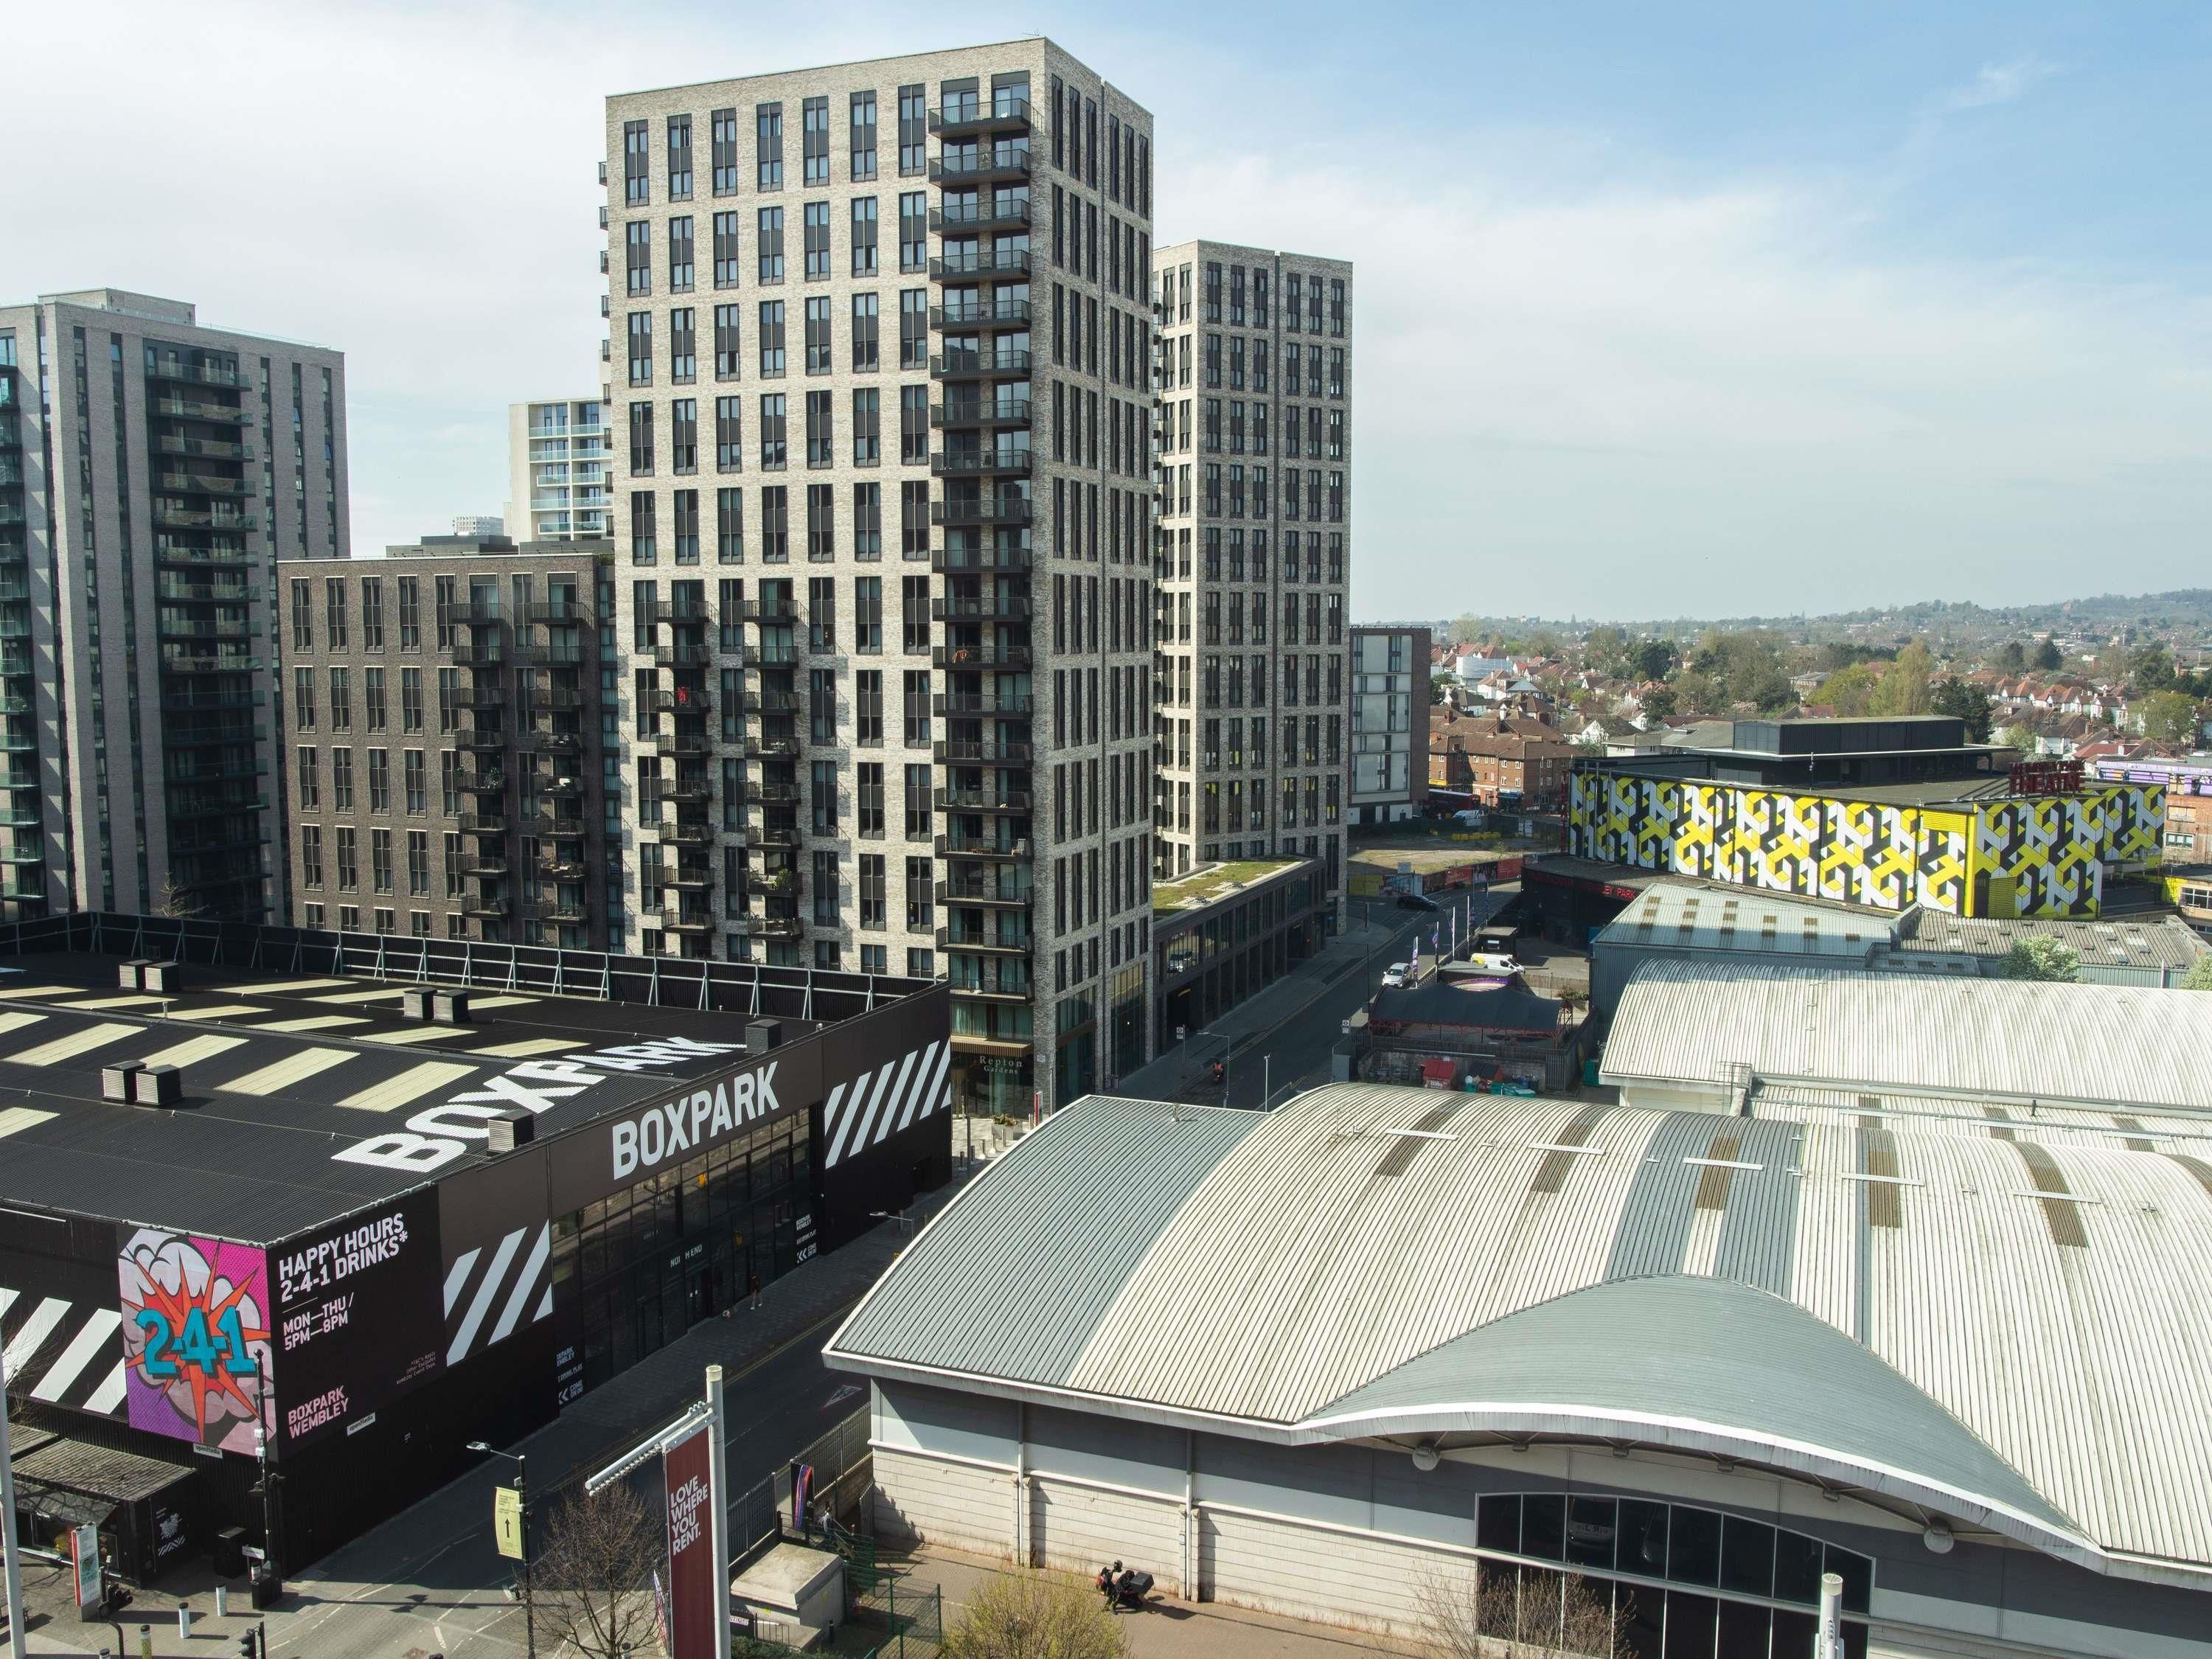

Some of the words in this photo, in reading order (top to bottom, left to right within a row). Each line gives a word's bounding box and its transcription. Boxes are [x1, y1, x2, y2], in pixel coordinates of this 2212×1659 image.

[2009, 772, 2085, 793] THEATRE
[1616, 888, 1636, 899] PARK
[980, 1056, 1023, 1068] Repton
[984, 1065, 1018, 1074] Gardens
[331, 1037, 746, 1172] BOXPARK
[612, 1061, 779, 1180] BOXPARK
[279, 1237, 341, 1281] HAPPY
[344, 1213, 404, 1254] HOURS
[690, 1245, 703, 1257] END
[280, 1264, 330, 1303] 2-4-1
[288, 1385, 345, 1425] BOXPARK
[289, 1397, 349, 1439] WEMBLEY
[670, 1475, 698, 1509] LOVE
[670, 1483, 708, 1523] WHERE
[672, 1509, 697, 1539] YOU
[672, 1522, 701, 1556] RENT.
